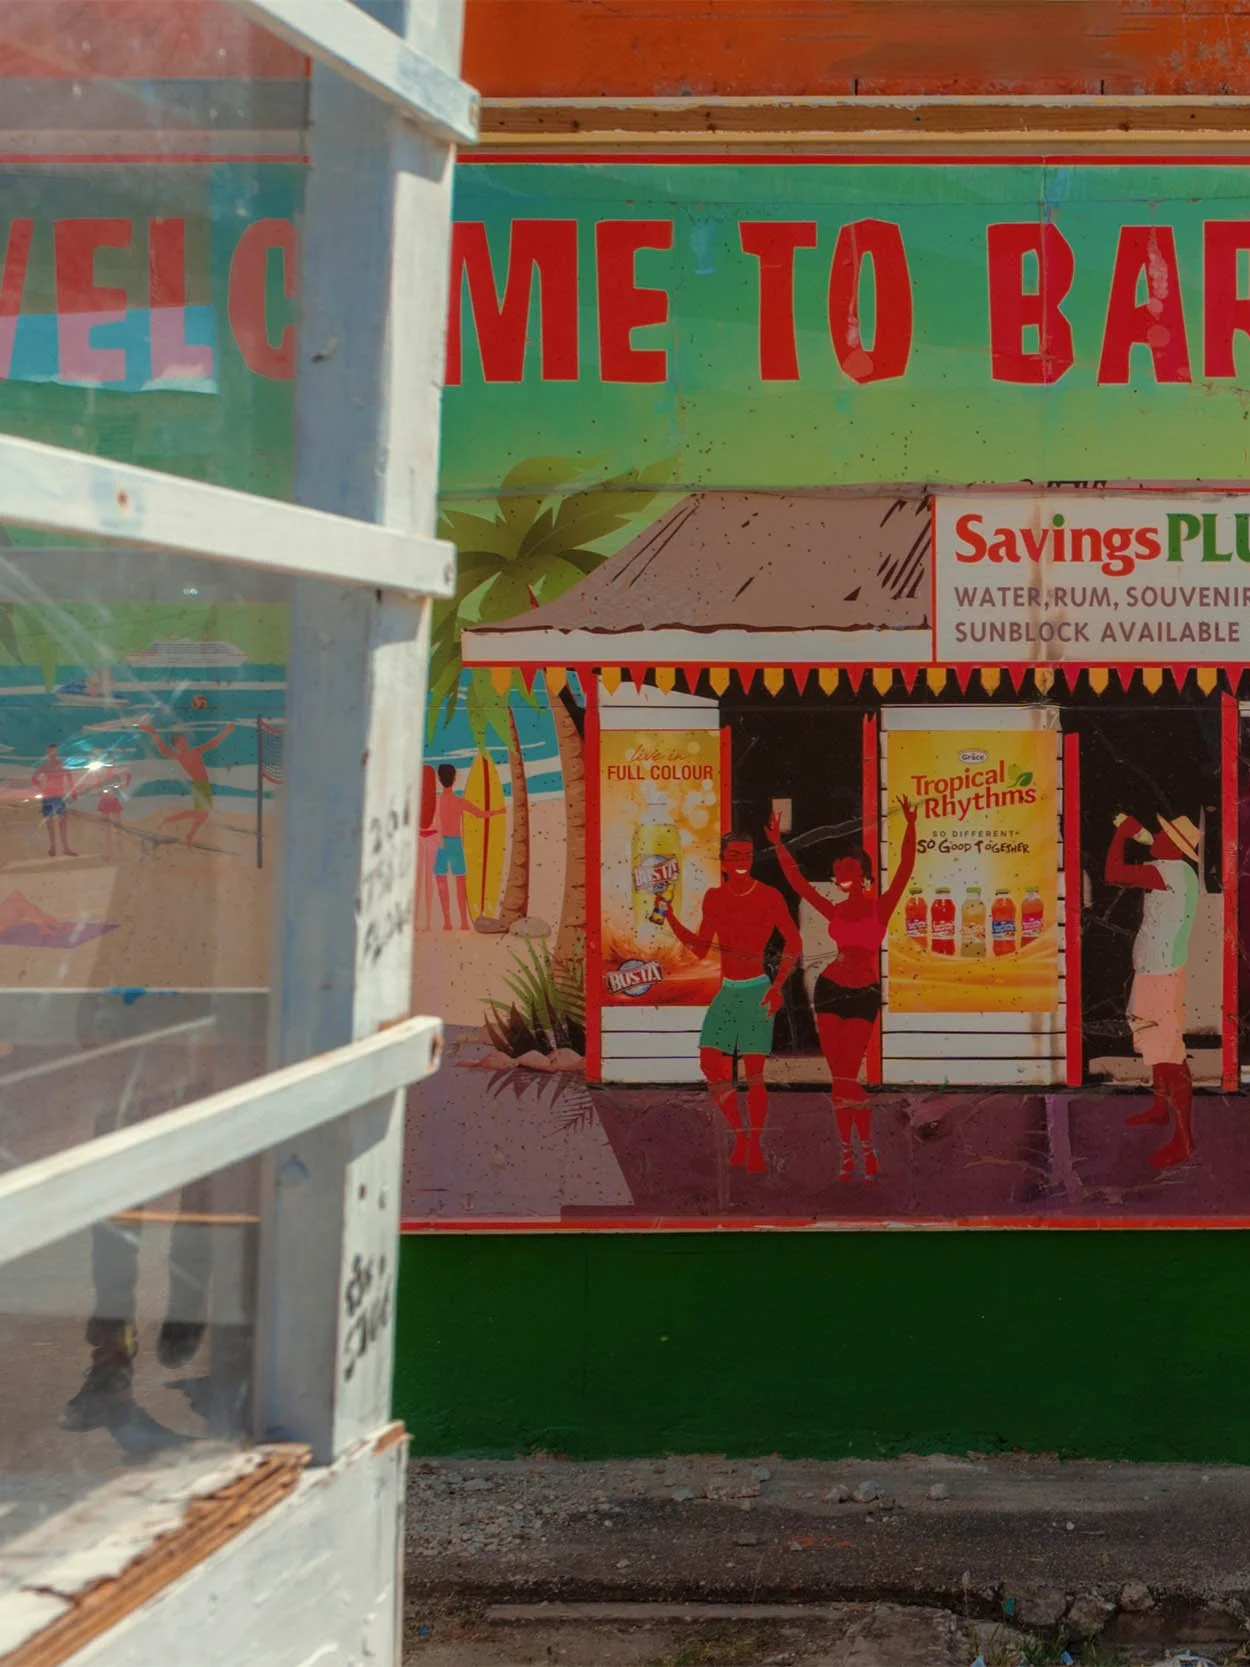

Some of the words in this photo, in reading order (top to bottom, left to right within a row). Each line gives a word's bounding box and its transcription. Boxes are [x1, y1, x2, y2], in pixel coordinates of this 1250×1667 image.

[0, 217, 674, 386] ELCME
[738, 217, 913, 386] TO
[954, 621, 1091, 643] SUNBLOCK
[1100, 621, 1241, 643] AVAILABLE
[607, 765, 646, 780] FULL
[650, 764, 714, 781] COLOUR
[911, 759, 1006, 800] Tropical
[924, 786, 1038, 822] Rhythms
[932, 830, 947, 838] SO
